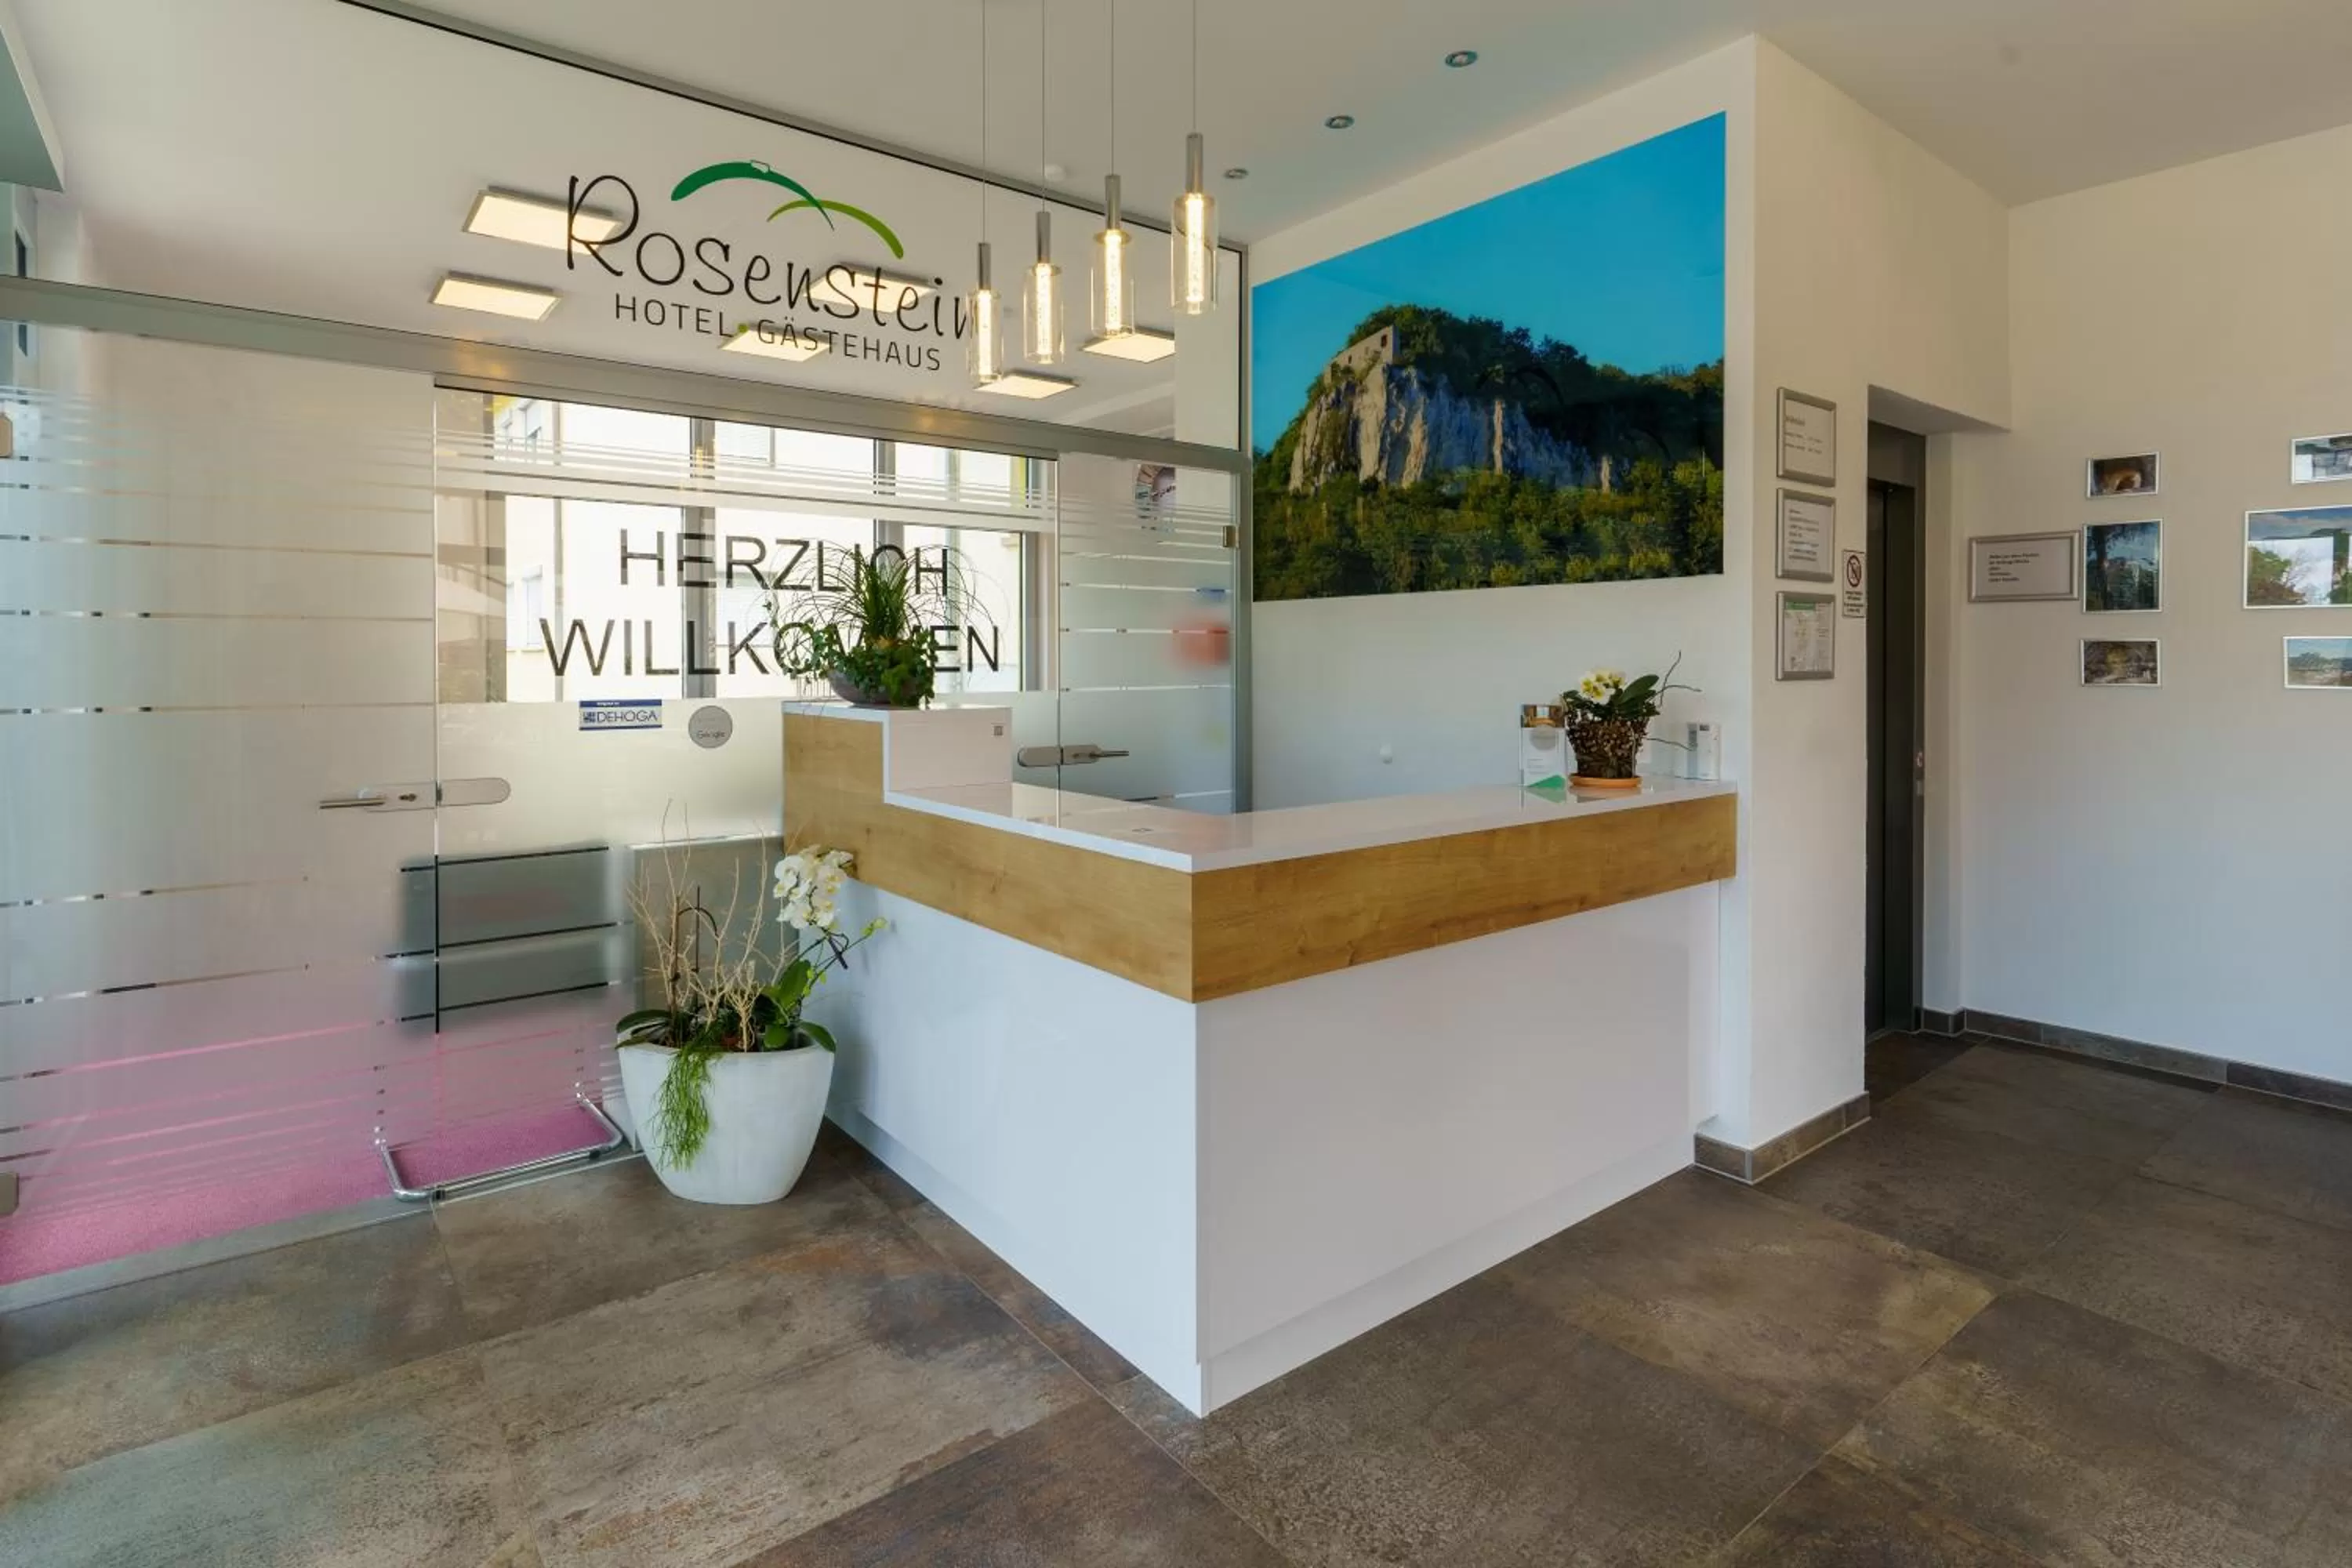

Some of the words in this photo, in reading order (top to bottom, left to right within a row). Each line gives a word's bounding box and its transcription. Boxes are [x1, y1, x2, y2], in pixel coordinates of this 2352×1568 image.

[615, 292, 733, 338] HOTEL
[757, 317, 941, 372] GÄSTEHAUS
[539, 618, 1000, 677] WILLKOEN
[596, 709, 659, 723] DEHOGA
